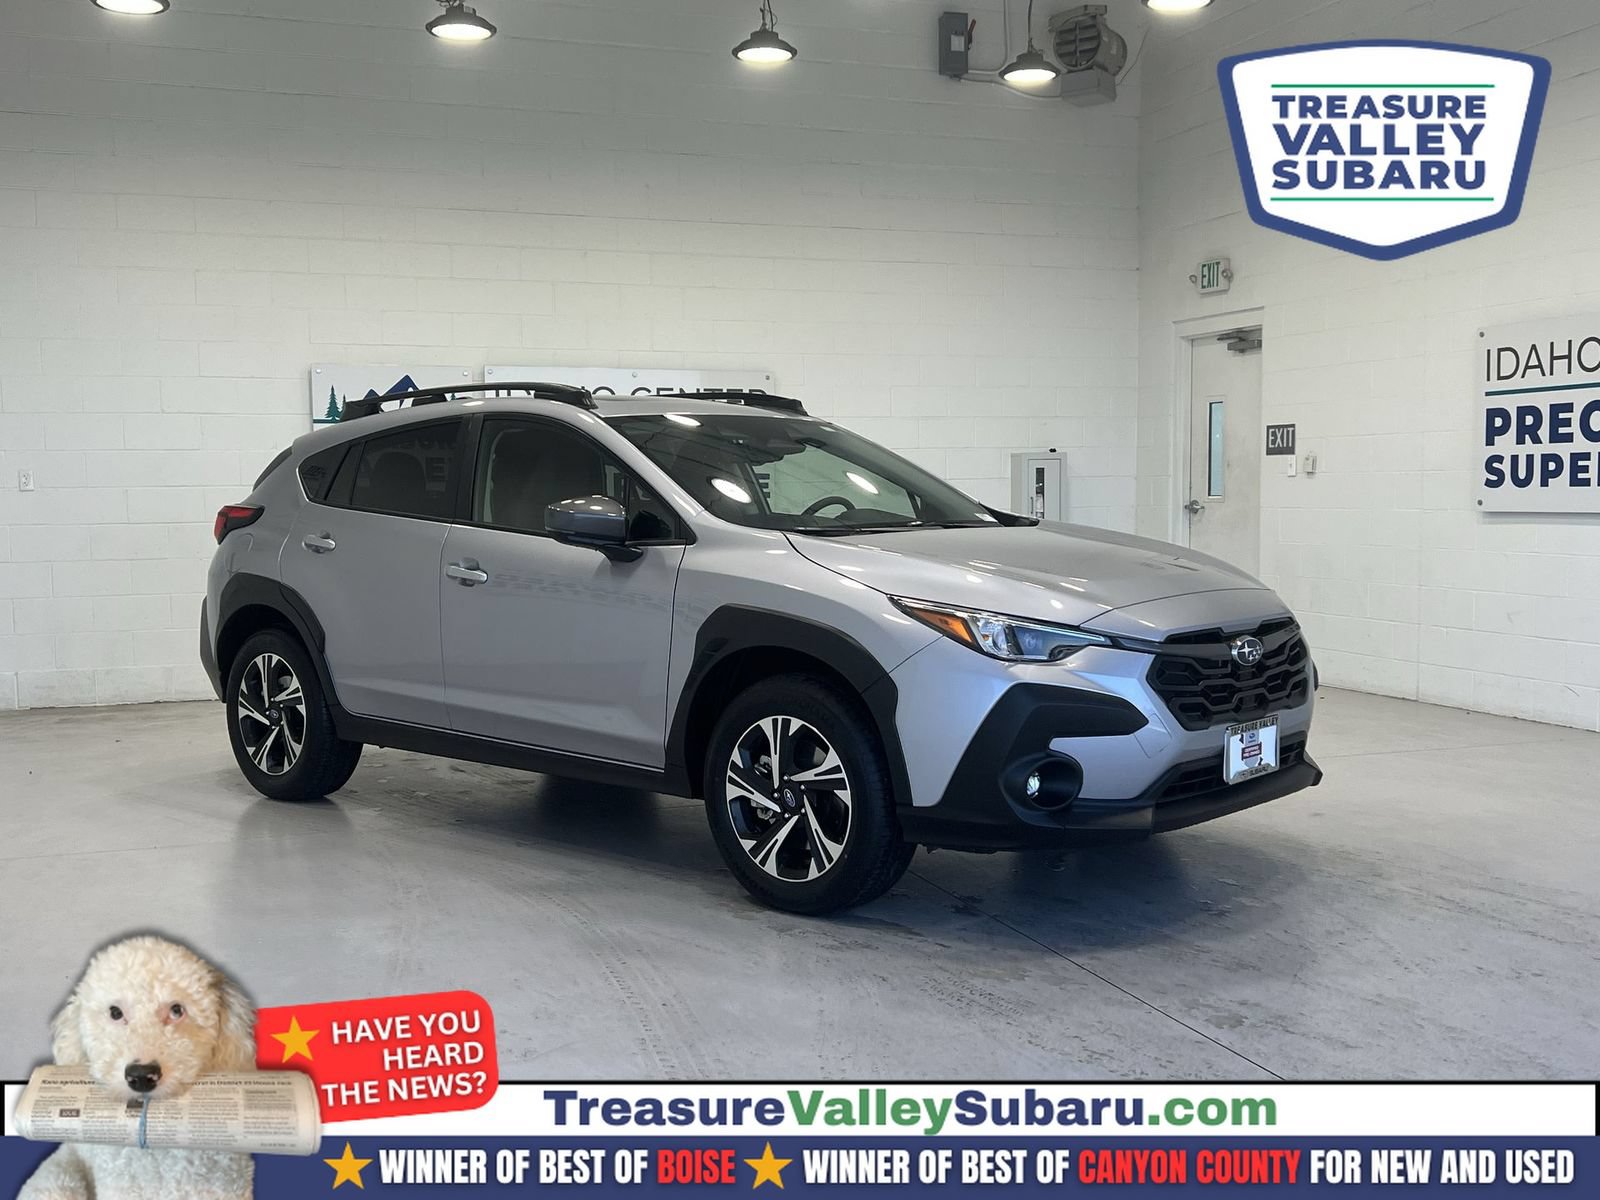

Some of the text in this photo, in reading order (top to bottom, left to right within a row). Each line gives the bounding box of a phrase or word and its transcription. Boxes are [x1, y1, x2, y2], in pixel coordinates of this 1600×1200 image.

[1201, 261, 1220, 289] EXIT
[1268, 427, 1295, 449] EXIT
[1484, 451, 1600, 489] SUPE
